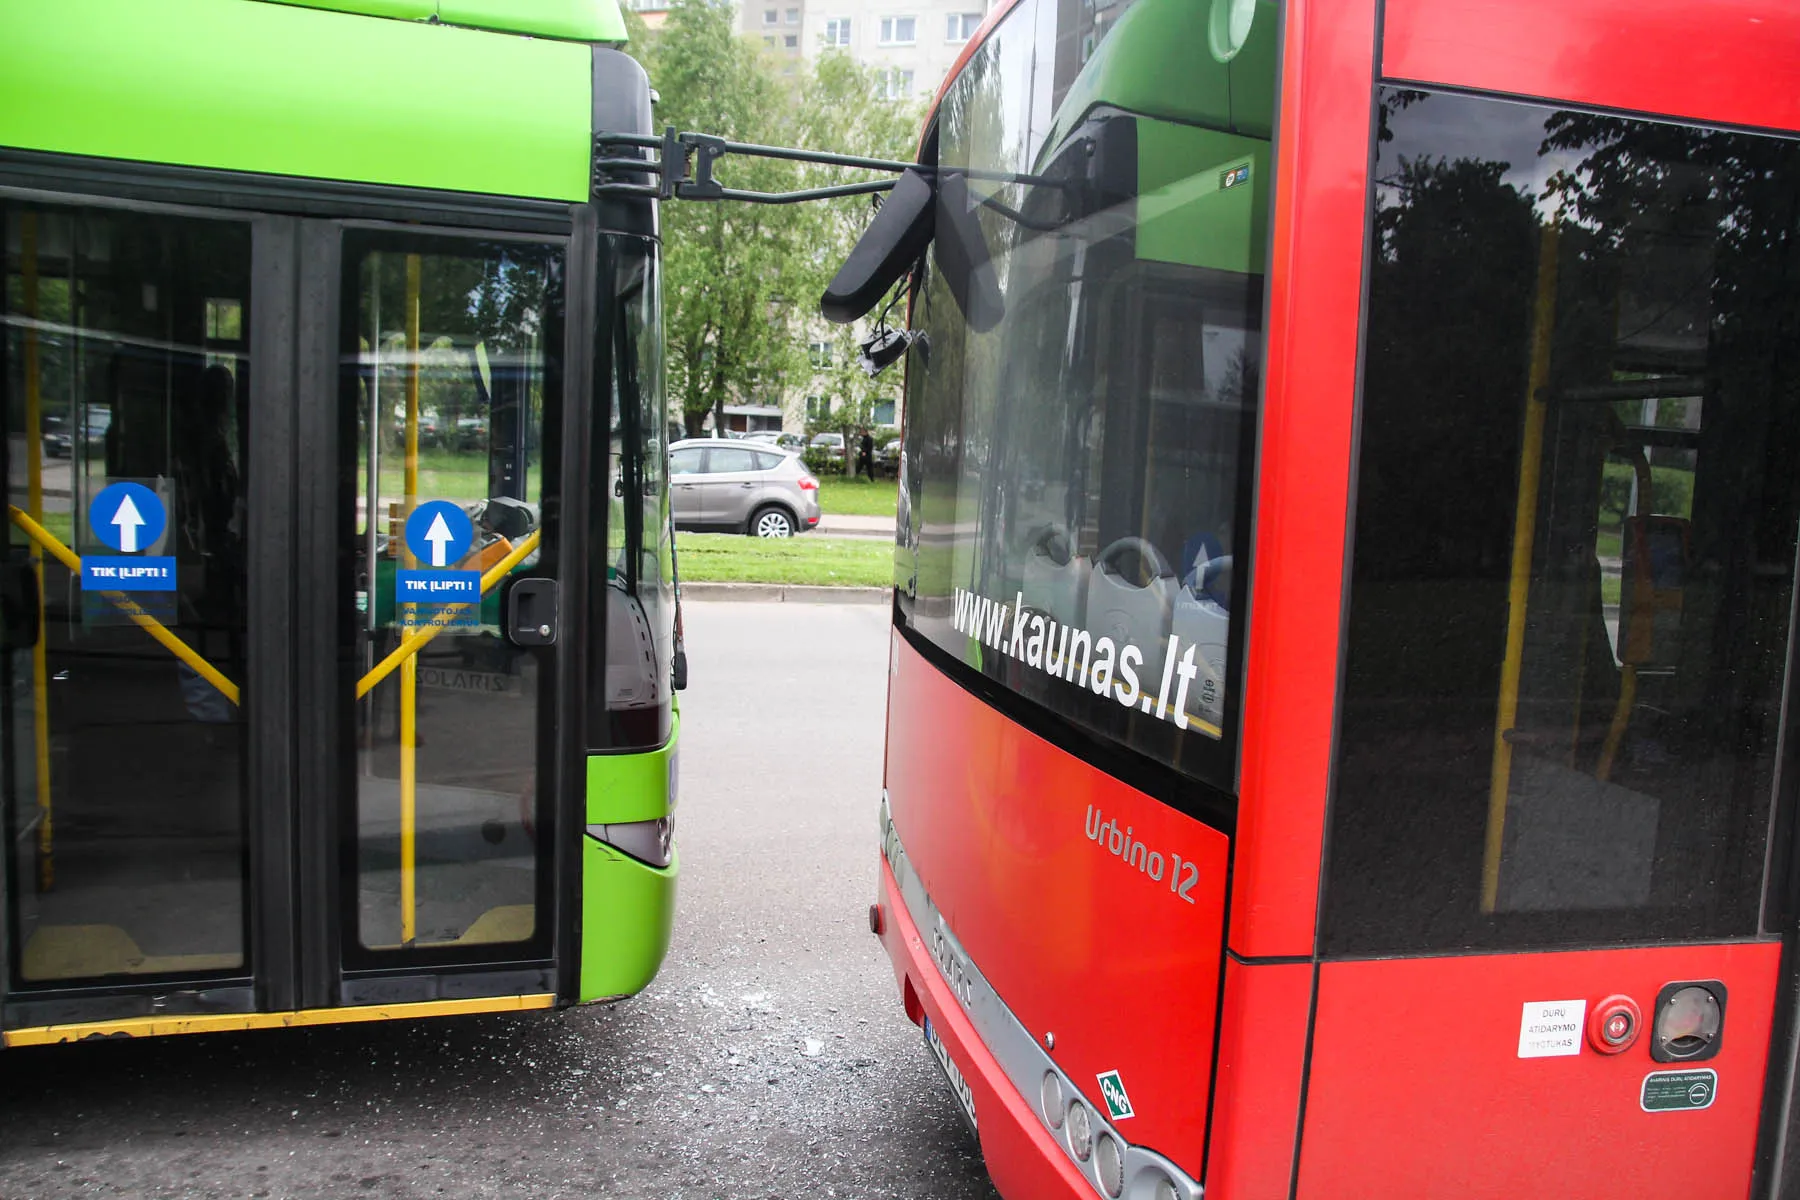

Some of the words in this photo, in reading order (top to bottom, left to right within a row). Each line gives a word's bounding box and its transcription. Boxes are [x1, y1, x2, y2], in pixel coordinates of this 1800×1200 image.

[90, 567, 117, 577] TIK
[119, 567, 159, 580] ĮLIPTI
[405, 580, 427, 590] TIK
[430, 581, 466, 592] ĮLIPTI
[954, 587, 1197, 730] www.kaunas.lt
[1085, 804, 1165, 881] Urbino
[1170, 853, 1199, 905] 12
[1103, 1078, 1127, 1114] CNG
